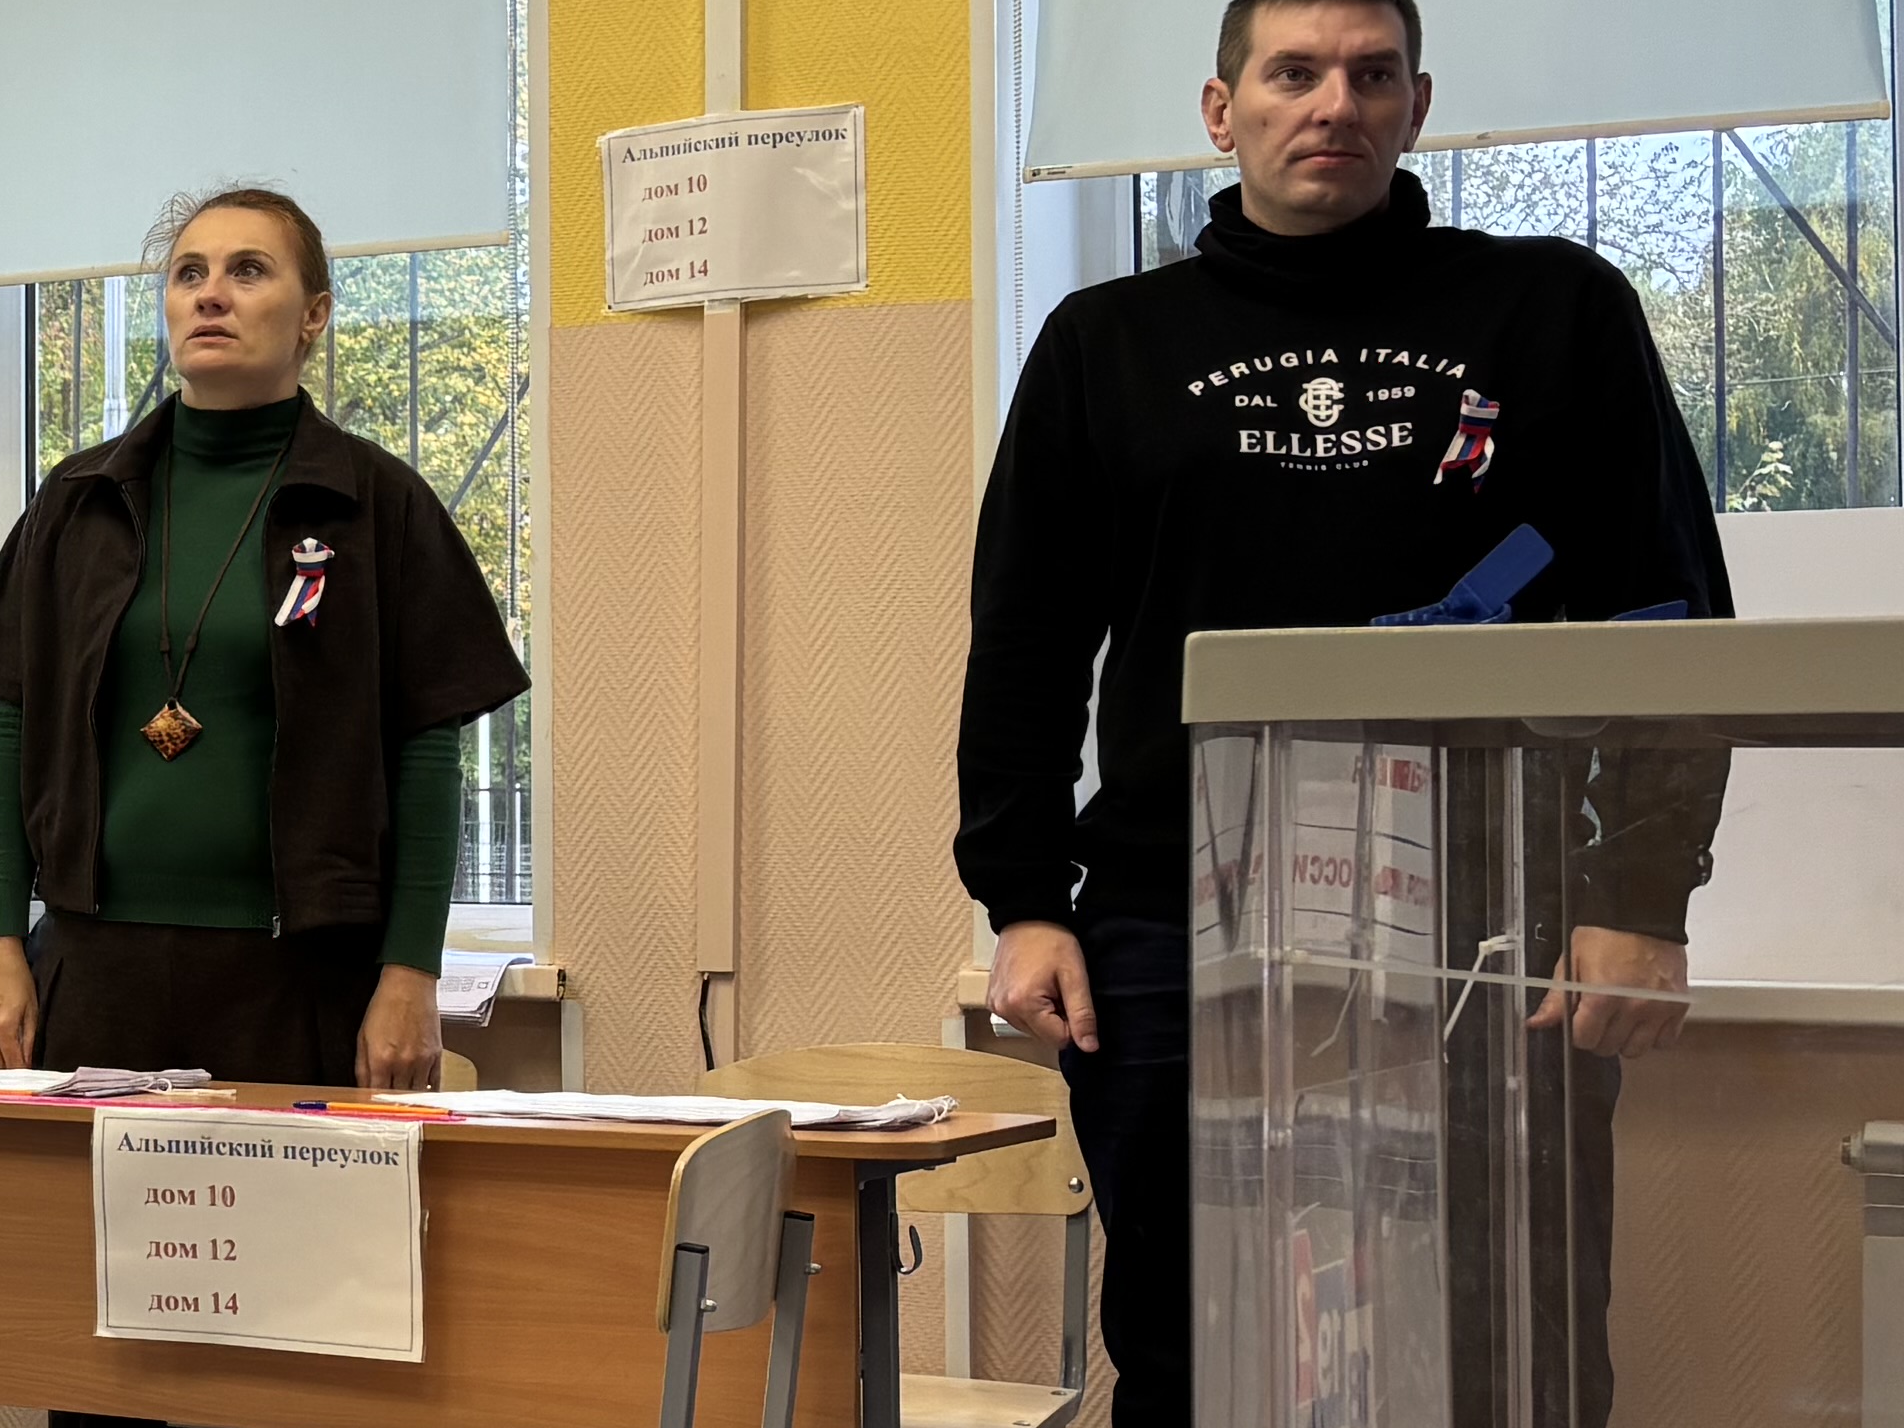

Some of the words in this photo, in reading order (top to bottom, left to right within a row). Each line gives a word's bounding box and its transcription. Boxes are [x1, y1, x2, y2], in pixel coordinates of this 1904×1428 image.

[622, 132, 739, 163] Альпийский
[747, 127, 848, 149] переулок
[642, 182, 679, 202] дом
[687, 173, 708, 194] 10
[642, 224, 680, 244] дом
[688, 217, 708, 236] 12
[643, 266, 680, 286] дом
[688, 259, 709, 279] 14
[1188, 348, 1339, 396] PERUGIA
[1359, 348, 1467, 379] ITALIA
[1234, 394, 1278, 408] DAL
[1366, 386, 1416, 402] 1959
[1238, 422, 1414, 458] ELLESSE
[117, 1131, 274, 1159] Альпийский
[283, 1145, 400, 1169] переулок
[144, 1187, 196, 1207] дом
[208, 1184, 236, 1208] 10
[146, 1240, 198, 1260] дом
[209, 1238, 238, 1261] 12
[148, 1293, 200, 1313] дом
[211, 1291, 239, 1315] 14
